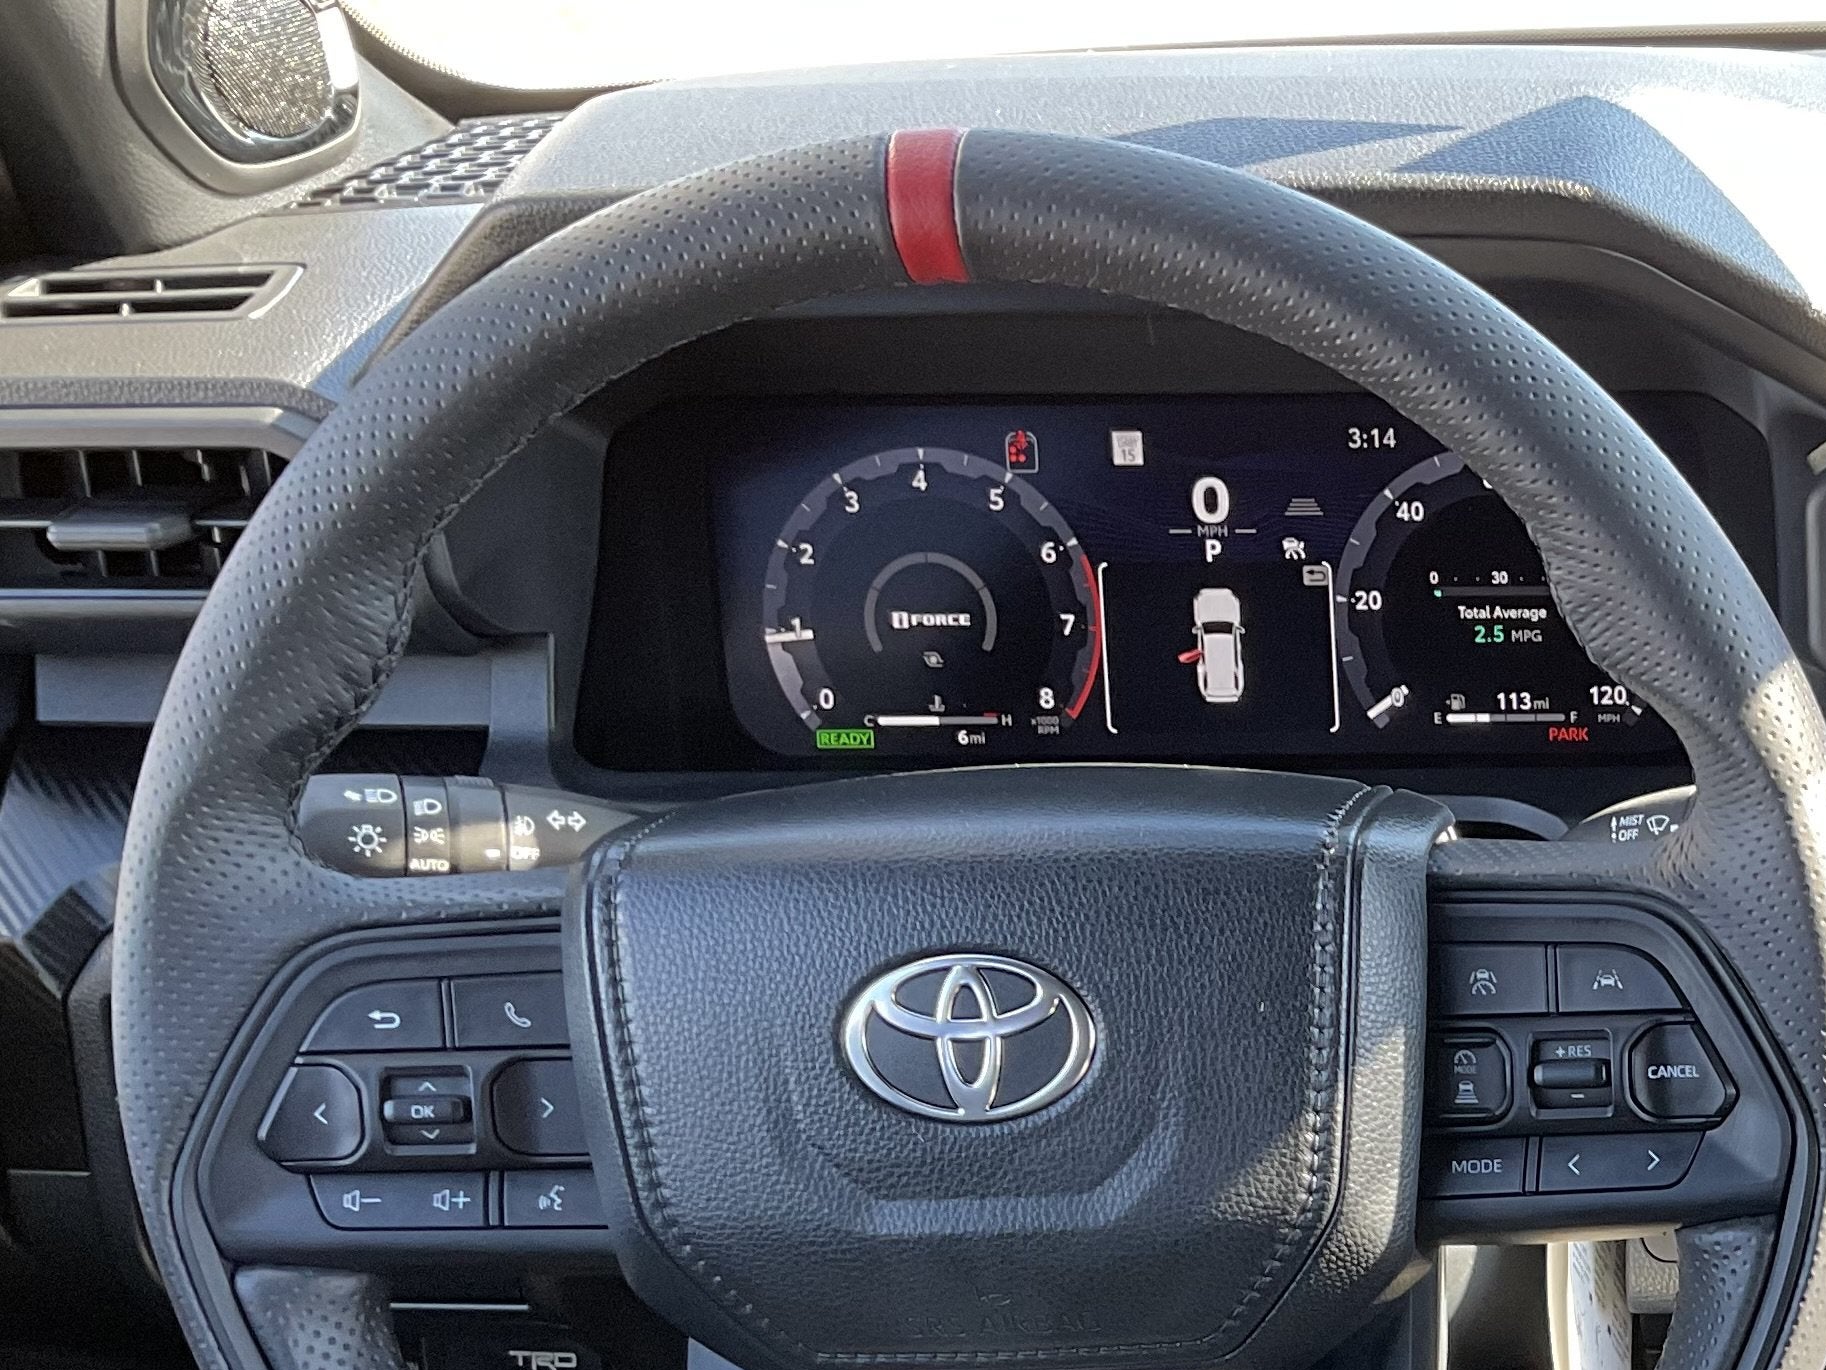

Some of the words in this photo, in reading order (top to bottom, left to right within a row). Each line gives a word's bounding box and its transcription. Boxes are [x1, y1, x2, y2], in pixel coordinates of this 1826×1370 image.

[1348, 427, 1397, 449] 3:14
[910, 470, 929, 491] 4
[844, 490, 861, 513] 3
[988, 488, 1005, 512] 5
[1191, 476, 1230, 524] 0
[1396, 500, 1424, 522] 40
[1196, 525, 1229, 538] MPH
[798, 543, 815, 566] 2
[1040, 541, 1057, 564] 6
[1205, 539, 1222, 563] P
[1429, 570, 1439, 584] 0
[1490, 570, 1508, 585] 30
[1354, 590, 1383, 611] 20
[1457, 605, 1492, 620] Total
[1493, 606, 1548, 623] Average
[1059, 613, 1076, 636] 7
[1474, 625, 1505, 644] 2.5
[1511, 629, 1543, 643] MPG
[818, 687, 835, 710] 0
[1038, 687, 1056, 709] 8
[1589, 686, 1628, 707] 120
[1001, 714, 1013, 727] H
[1434, 712, 1442, 724] E
[1570, 711, 1578, 723] F
[820, 731, 871, 747] READY
[1548, 726, 1590, 742] PARK
[1618, 814, 1645, 828] MIST
[1618, 828, 1639, 842] OFF
[409, 858, 450, 872] AUTO
[1647, 1065, 1700, 1080] CANCEL
[410, 1103, 435, 1119] OK
[1451, 1158, 1503, 1175] MODE
